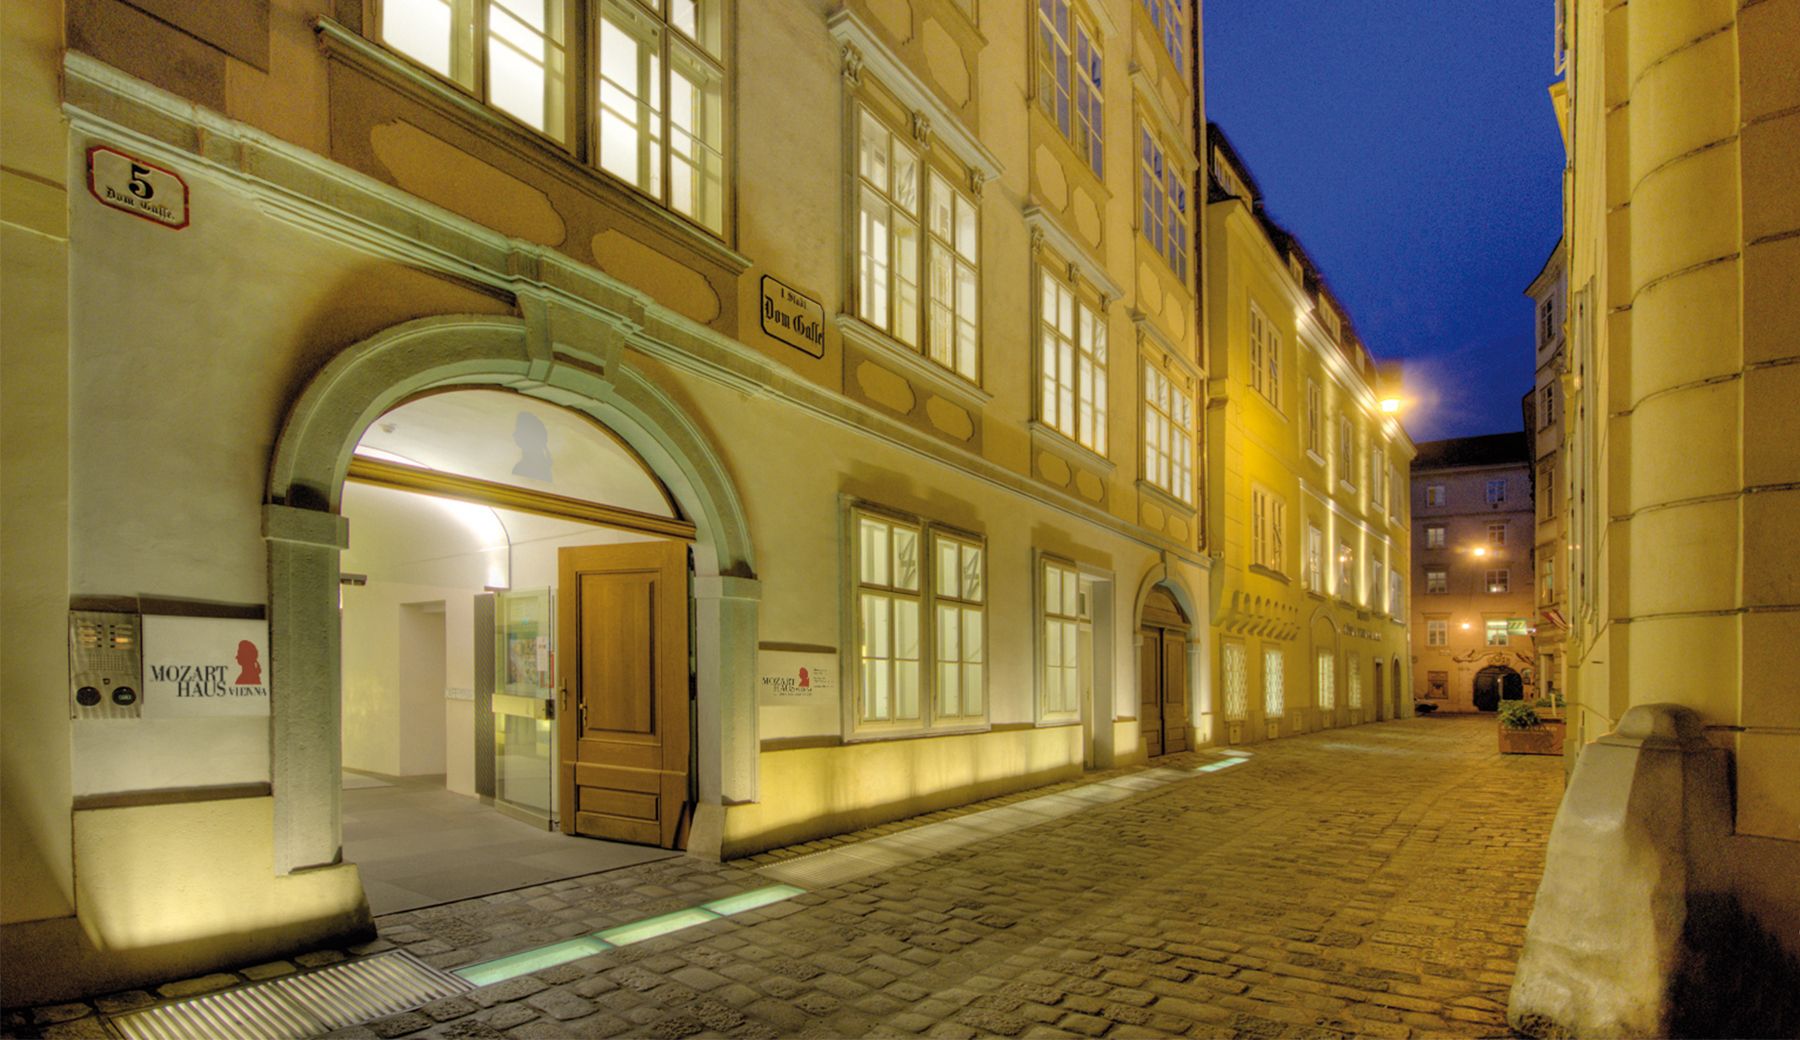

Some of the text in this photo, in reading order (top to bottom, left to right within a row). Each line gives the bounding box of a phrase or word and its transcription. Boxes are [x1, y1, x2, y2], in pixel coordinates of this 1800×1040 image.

[128, 163, 154, 200] 5
[105, 186, 134, 206] Dom
[765, 294, 790, 330] Dom
[150, 665, 228, 682] MOZART
[176, 680, 267, 697] HAUS VIENNA
